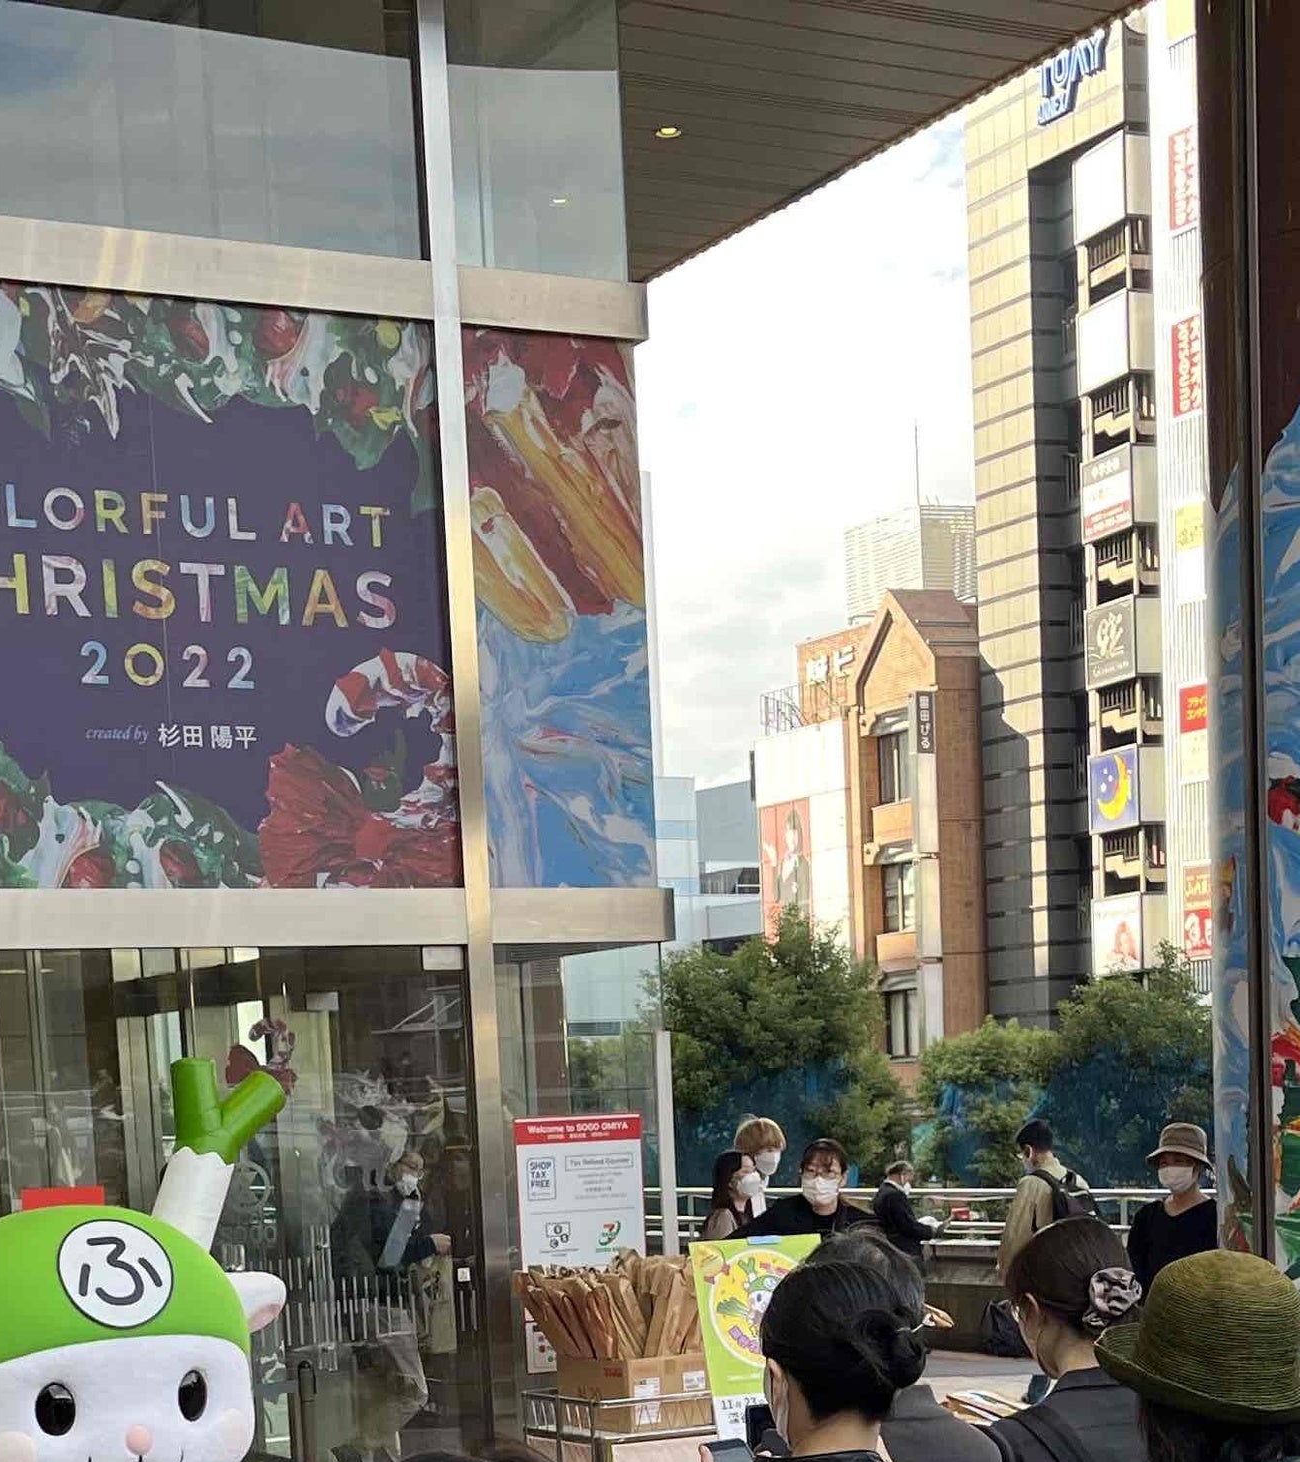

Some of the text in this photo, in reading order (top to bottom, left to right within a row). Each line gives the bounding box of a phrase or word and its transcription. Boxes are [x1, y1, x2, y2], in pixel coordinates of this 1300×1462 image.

[278, 501, 390, 549] ART
[80, 641, 256, 689] 2022
[86, 723, 258, 749] created by 杉田 陽平
[527, 1125, 564, 1134] Welcome
[566, 1124, 575, 1132] to
[530, 1162, 551, 1170] SHOP
[530, 1171, 546, 1179] TAX
[530, 1180, 550, 1188] FREE
[78, 1236, 164, 1306] ふ
